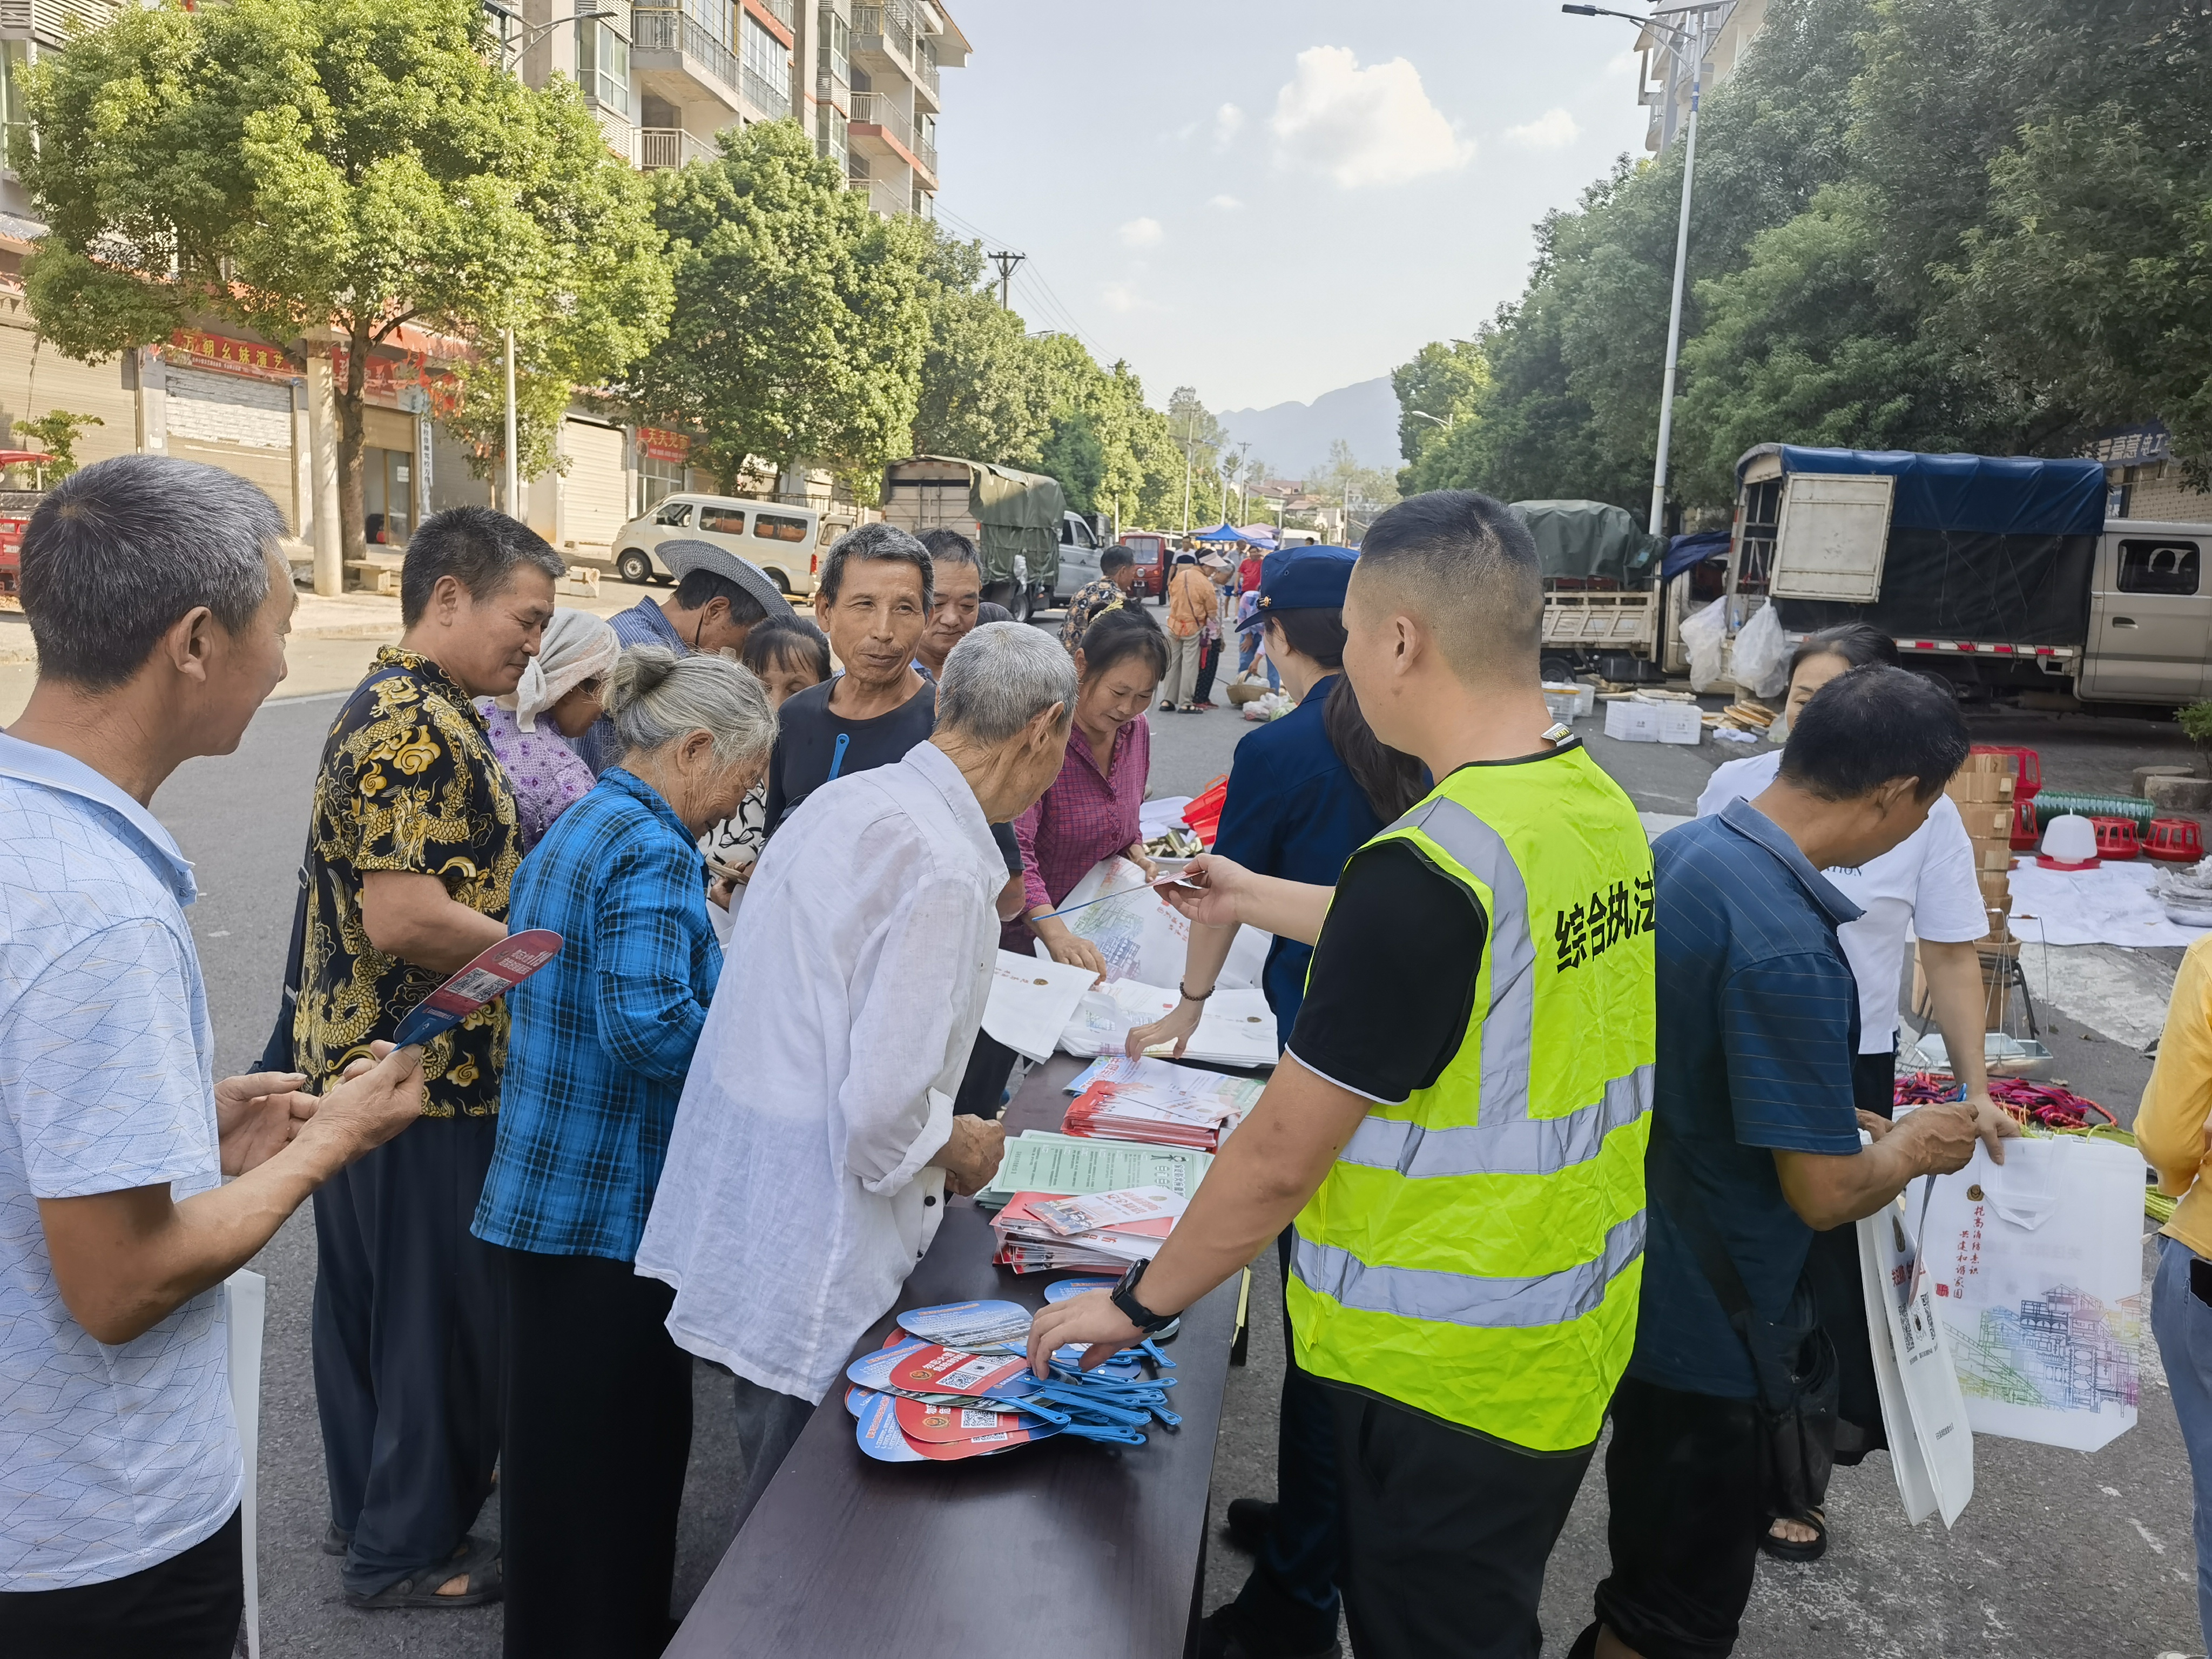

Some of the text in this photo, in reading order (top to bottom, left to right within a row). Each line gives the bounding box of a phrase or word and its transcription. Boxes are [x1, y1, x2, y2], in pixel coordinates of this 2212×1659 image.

[648, 428, 689, 450] 天天见面
[1555, 871, 1655, 974] 综合执法
[1953, 1230, 1969, 1299] 共建和谐家园
[1969, 1205, 1985, 1274] 提高消防意识
